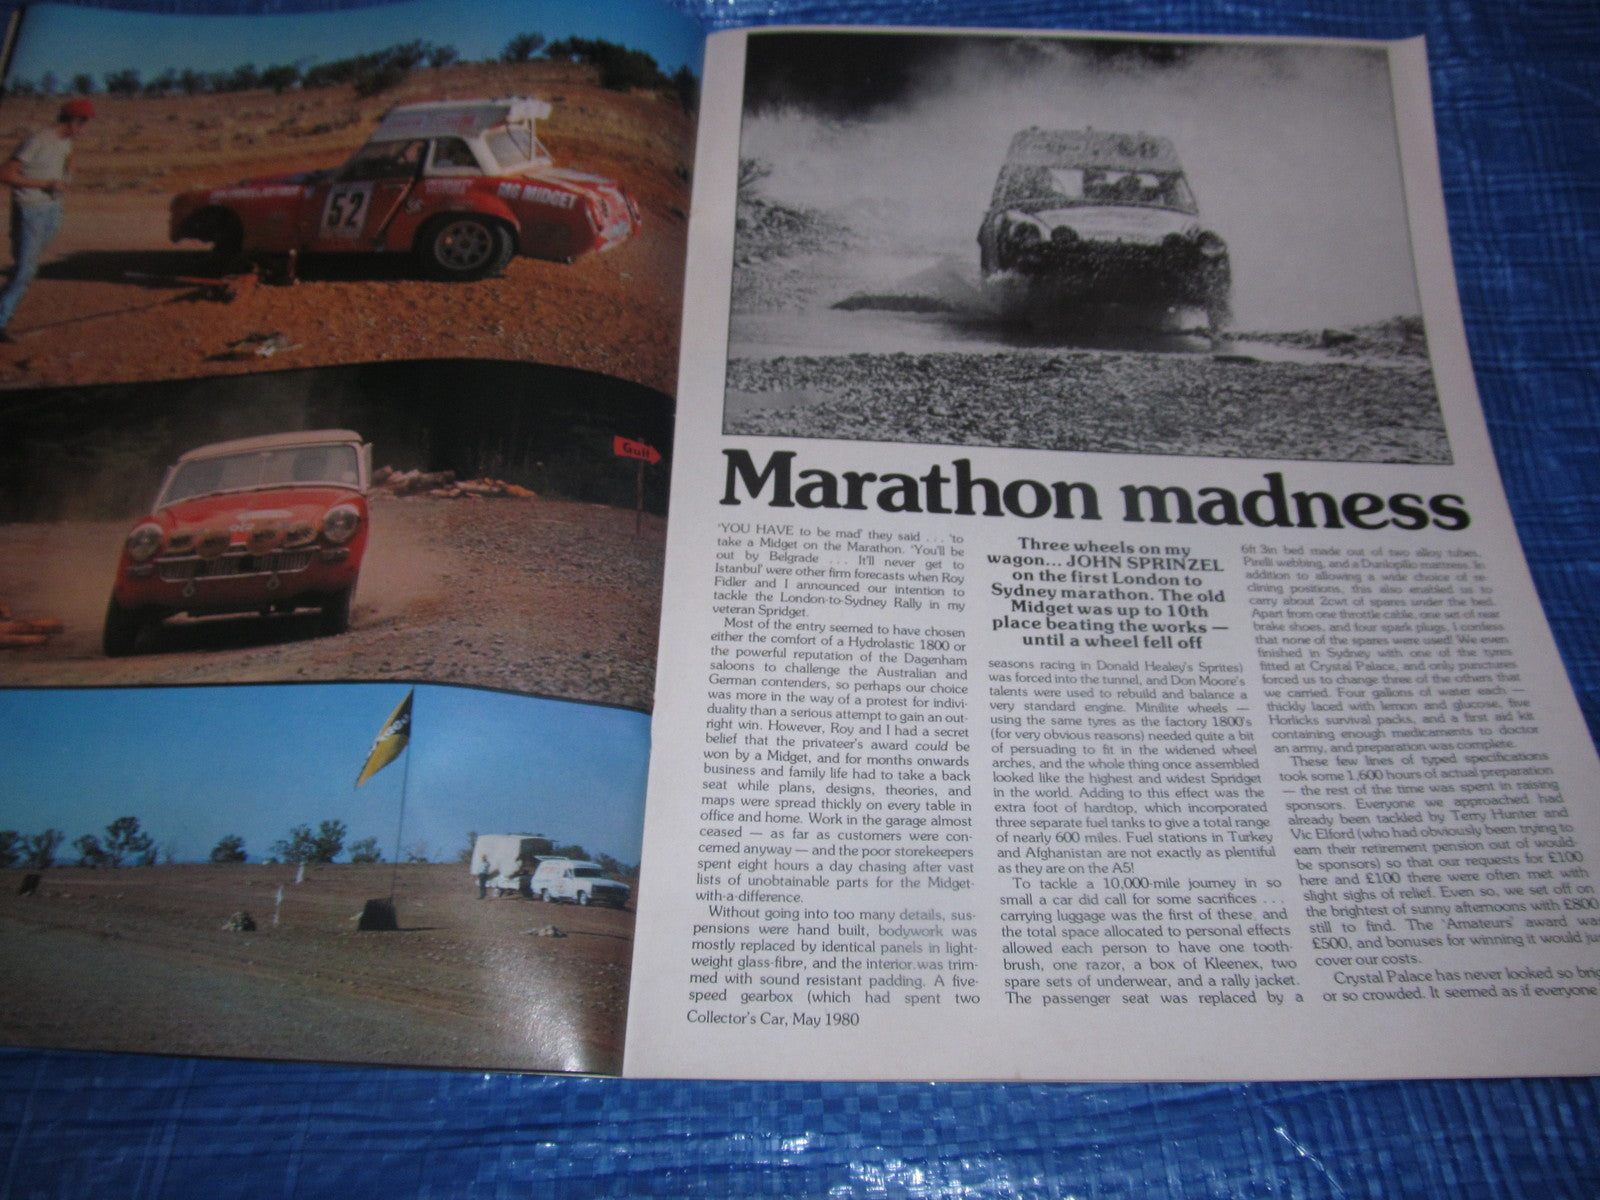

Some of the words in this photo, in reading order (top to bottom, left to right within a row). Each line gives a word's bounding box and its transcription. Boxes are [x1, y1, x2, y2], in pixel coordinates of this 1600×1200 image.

[328, 191, 365, 228] 52
[719, 449, 1103, 520] Marathon
[1120, 473, 1471, 531] madness
[1019, 537, 1070, 551] Three
[1073, 538, 1135, 554] wheels
[1138, 545, 1161, 554] on
[1164, 546, 1190, 558] my
[1066, 554, 1122, 569] JOHN
[1126, 556, 1223, 572] SPRINZEL
[1012, 572, 1034, 581] on
[1038, 568, 1067, 582] the
[1070, 569, 1108, 584] first
[1112, 571, 1180, 586] London
[1184, 575, 1202, 586] to
[713, 586, 748, 601] tackle
[754, 588, 774, 602] the
[893, 595, 922, 612] Rally
[928, 597, 940, 610] in
[947, 602, 965, 614] my
[990, 583, 1056, 601] Sydney
[1060, 585, 1153, 600] marathon.
[1159, 588, 1192, 602] The
[1196, 589, 1225, 602] old
[1011, 599, 1073, 617] Midget
[1077, 605, 1113, 615] was
[1116, 606, 1140, 619] up
[1144, 605, 1162, 617] to
[1168, 604, 1208, 618] 10th
[724, 614, 754, 629] Most
[757, 616, 770, 630] of
[773, 617, 792, 630] the
[795, 620, 826, 635] entry
[828, 619, 874, 634] seemed
[876, 623, 890, 635] to
[892, 622, 920, 636] have
[924, 623, 965, 638] chosen
[992, 615, 1042, 632] place
[1045, 616, 1114, 634] beating
[1118, 618, 1148, 632] the
[1151, 619, 1207, 633] works
[710, 628, 743, 642] either
[748, 629, 767, 643] the
[770, 630, 816, 645] comfort
[820, 633, 833, 646] of
[836, 637, 844, 647] a
[848, 634, 914, 653] Hydrolastic
[920, 637, 950, 651] 1800
[953, 642, 965, 652] or
[1022, 632, 1064, 646] until
[1069, 637, 1080, 647] a
[1084, 634, 1138, 648] wheel
[1142, 635, 1173, 648] fell
[1177, 636, 1202, 649] off
[708, 671, 756, 686] German
[760, 674, 830, 691] contenders,
[835, 680, 850, 690] so
[853, 677, 902, 695] perhaps
[905, 683, 926, 693] our
[930, 680, 968, 695] choice
[988, 674, 1012, 683] was
[1014, 670, 1052, 684] forced
[1054, 671, 1078, 684] into
[1079, 671, 1100, 684] the
[1101, 672, 1142, 687] tunnel,
[1145, 672, 1168, 686] and
[1169, 673, 1196, 686] Don
[1198, 673, 1245, 687] Moore's
[990, 712, 1022, 728] using
[1026, 712, 1046, 726] the
[1050, 717, 1082, 726] same
[1087, 715, 1117, 729] tyres
[1121, 717, 1136, 726] as
[1140, 713, 1160, 727] the
[1164, 714, 1207, 730] factory
[1212, 714, 1252, 728] 1800's
[703, 750, 730, 760] won
[734, 747, 750, 764] by
[754, 752, 762, 761] a
[766, 748, 811, 766] Midget,
[816, 750, 840, 763] and
[844, 750, 862, 764] for
[866, 751, 912, 766] months
[916, 753, 969, 767] onwards
[700, 796, 735, 809] maps
[740, 797, 770, 807] were
[774, 794, 816, 811] spread
[820, 795, 862, 812] thickly
[866, 800, 882, 810] on
[887, 801, 920, 814] every
[924, 798, 956, 812] table
[960, 799, 972, 812] in
[1302, 888, 1338, 905] slight
[1342, 887, 1377, 904] sighs
[1380, 886, 1395, 900] of
[1398, 885, 1432, 899] relief.
[1439, 884, 1475, 898] Even
[1503, 886, 1524, 896] we
[1528, 884, 1548, 895] set
[1552, 881, 1572, 894] off
[1576, 884, 1594, 894] on
[1000, 924, 1022, 938] the
[1026, 924, 1056, 937] total
[1061, 928, 1100, 940] space
[1104, 924, 1164, 937] allocated
[1167, 926, 1182, 936] to
[1184, 923, 1243, 939] personal
[1246, 923, 1290, 936] effects
[691, 937, 735, 954] mostly
[740, 938, 795, 954] replaced
[800, 939, 817, 955] by
[821, 939, 876, 953] identical
[880, 940, 923, 956] panels
[928, 941, 940, 954] in
[945, 941, 976, 957] light-
[1002, 957, 1044, 972] brush,
[1052, 961, 1078, 970] one
[1085, 961, 1124, 972] razor,
[1133, 961, 1142, 970] a
[1148, 956, 1175, 970] box
[1182, 956, 1197, 969] of
[1204, 956, 1263, 971] Kleenex,
[1270, 958, 1297, 969] two
[1314, 956, 1353, 966] cover
[1354, 956, 1378, 965] our
[1380, 953, 1421, 964] costs.
[1006, 991, 1032, 1004] The
[1042, 995, 1110, 1007] passenger
[1121, 993, 1149, 1004] seat
[1160, 994, 1188, 1004] was
[1198, 990, 1257, 1006] replaced
[1266, 990, 1284, 1006] by
[1294, 994, 1303, 1003] a
[1322, 992, 1337, 1001] or
[1341, 991, 1359, 1001] so
[1361, 986, 1425, 1000] crowded.
[1429, 985, 1440, 999] It
[1444, 984, 1498, 998] seemed
[1501, 988, 1518, 997] as
[1520, 983, 1531, 996] if
[1533, 986, 1598, 999] everyone
[686, 1010, 756, 1024] Collector's
[759, 1011, 788, 1026] Car,
[792, 1012, 821, 1028] May
[826, 1012, 859, 1026] 1980
